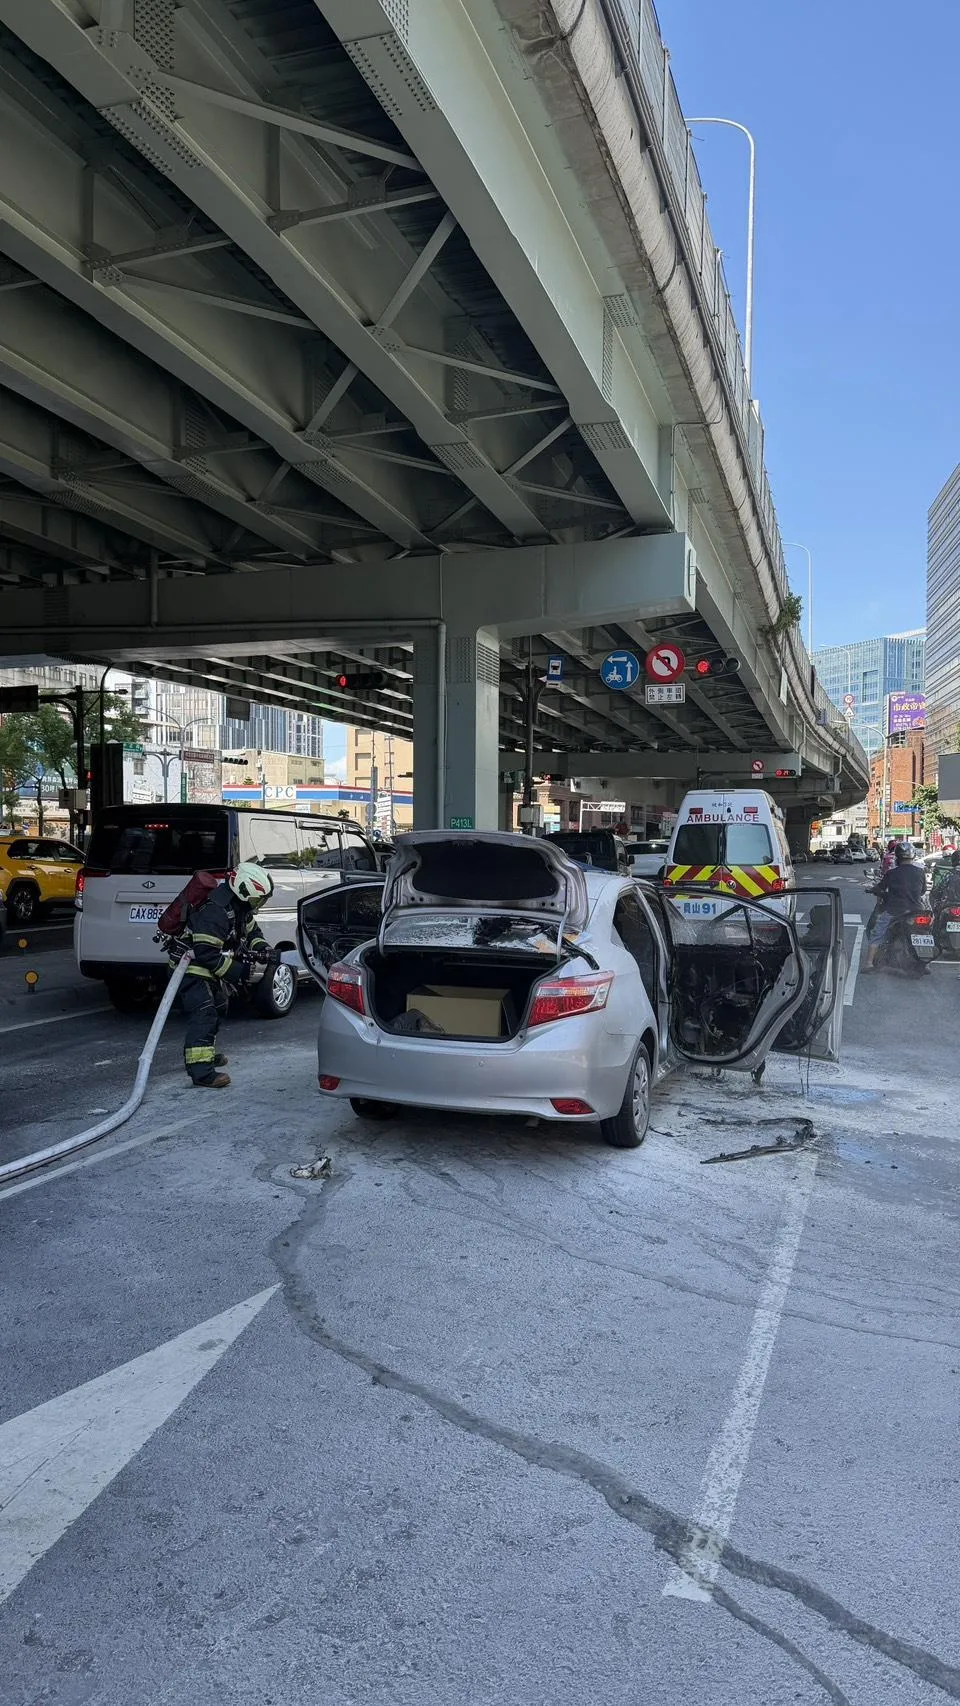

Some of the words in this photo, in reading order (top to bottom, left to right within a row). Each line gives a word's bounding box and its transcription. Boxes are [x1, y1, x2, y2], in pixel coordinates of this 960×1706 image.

[265, 786, 294, 799] CPC
[450, 818, 472, 828] P413L
[686, 813, 760, 823] AMBULANCE
